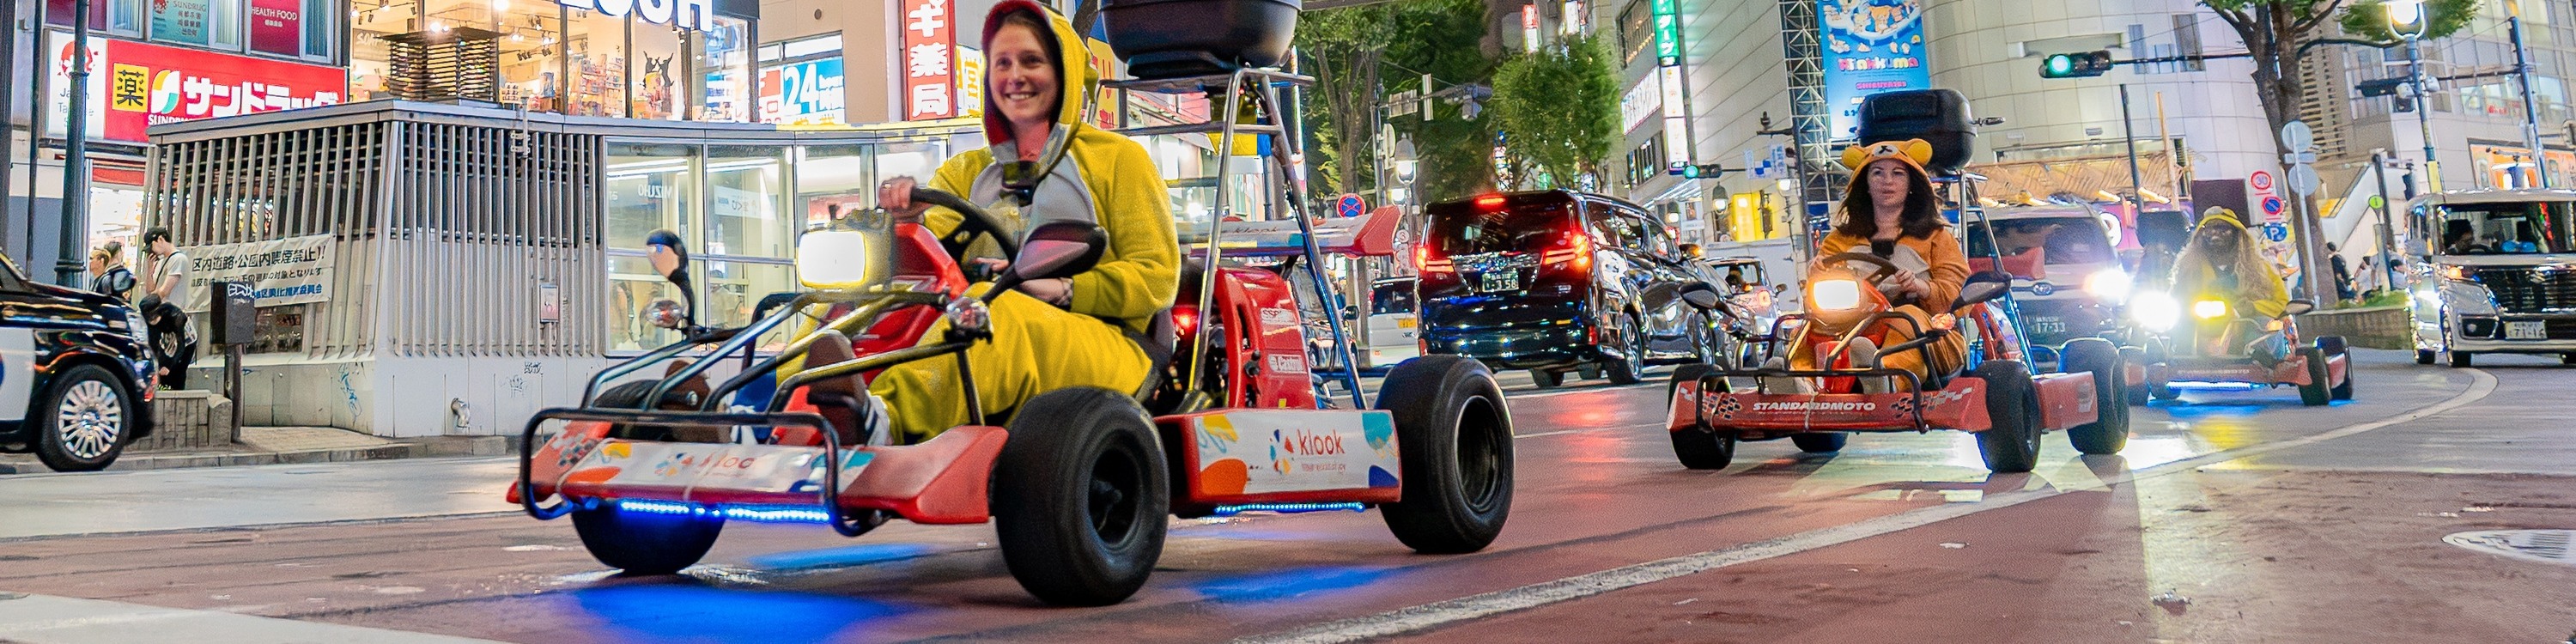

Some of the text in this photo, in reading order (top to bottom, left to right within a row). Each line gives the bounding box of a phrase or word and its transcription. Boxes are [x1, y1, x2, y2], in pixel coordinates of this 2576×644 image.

[173, 1, 206, 12] SUNDRUG
[251, 7, 297, 21] HEALTH FOOD
[117, 70, 144, 106] 薬
[784, 64, 820, 115] 24
[1753, 401, 1876, 411] STANDARDMOTO
[1297, 428, 1346, 456] klook
